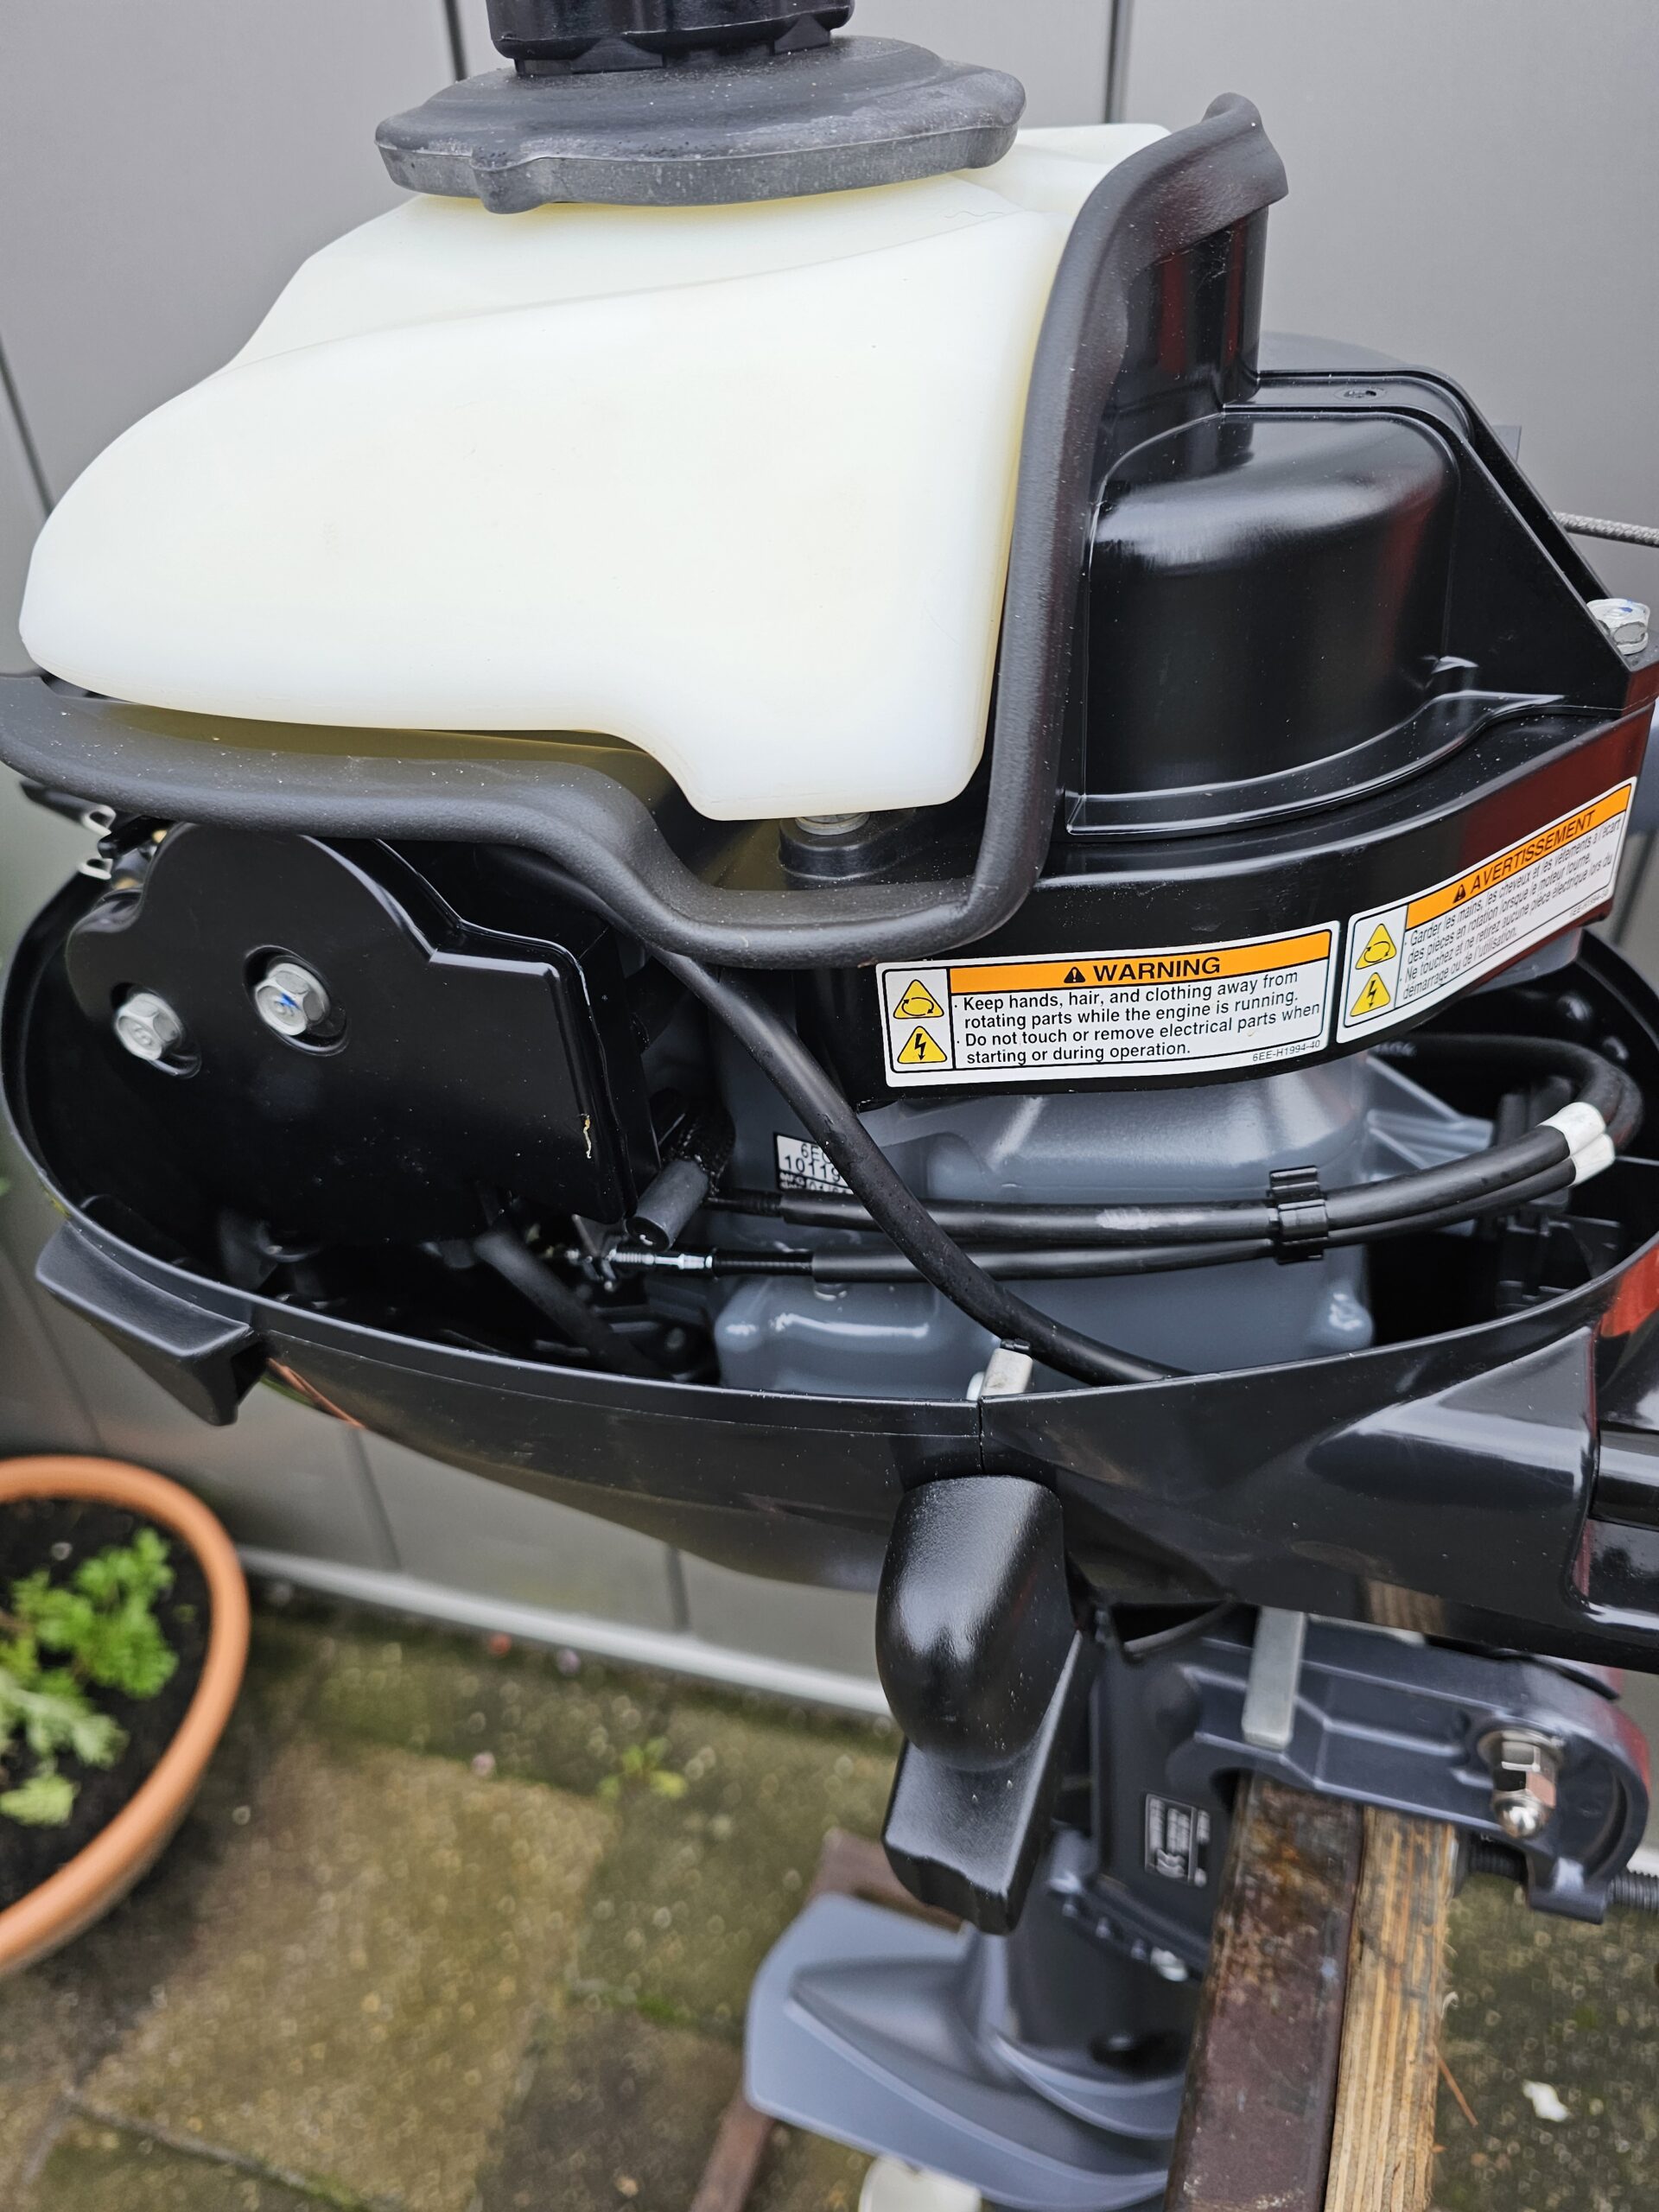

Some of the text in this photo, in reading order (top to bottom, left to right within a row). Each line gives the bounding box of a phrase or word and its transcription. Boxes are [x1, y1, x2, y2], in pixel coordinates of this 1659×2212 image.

[1471, 810, 1595, 893] AVERTISSEMENT
[1093, 957, 1220, 982] WARNING
[963, 971, 1298, 1014] Keep hands, hair, and clothing away from
[965, 990, 1298, 1030] rotating parts while the engine is running.
[966, 1003, 1319, 1046] Do not touch or remove electrical parts when
[967, 1042, 1191, 1065] starting or during operation.
[1253, 1039, 1320, 1061] 6EE-H1994-40
